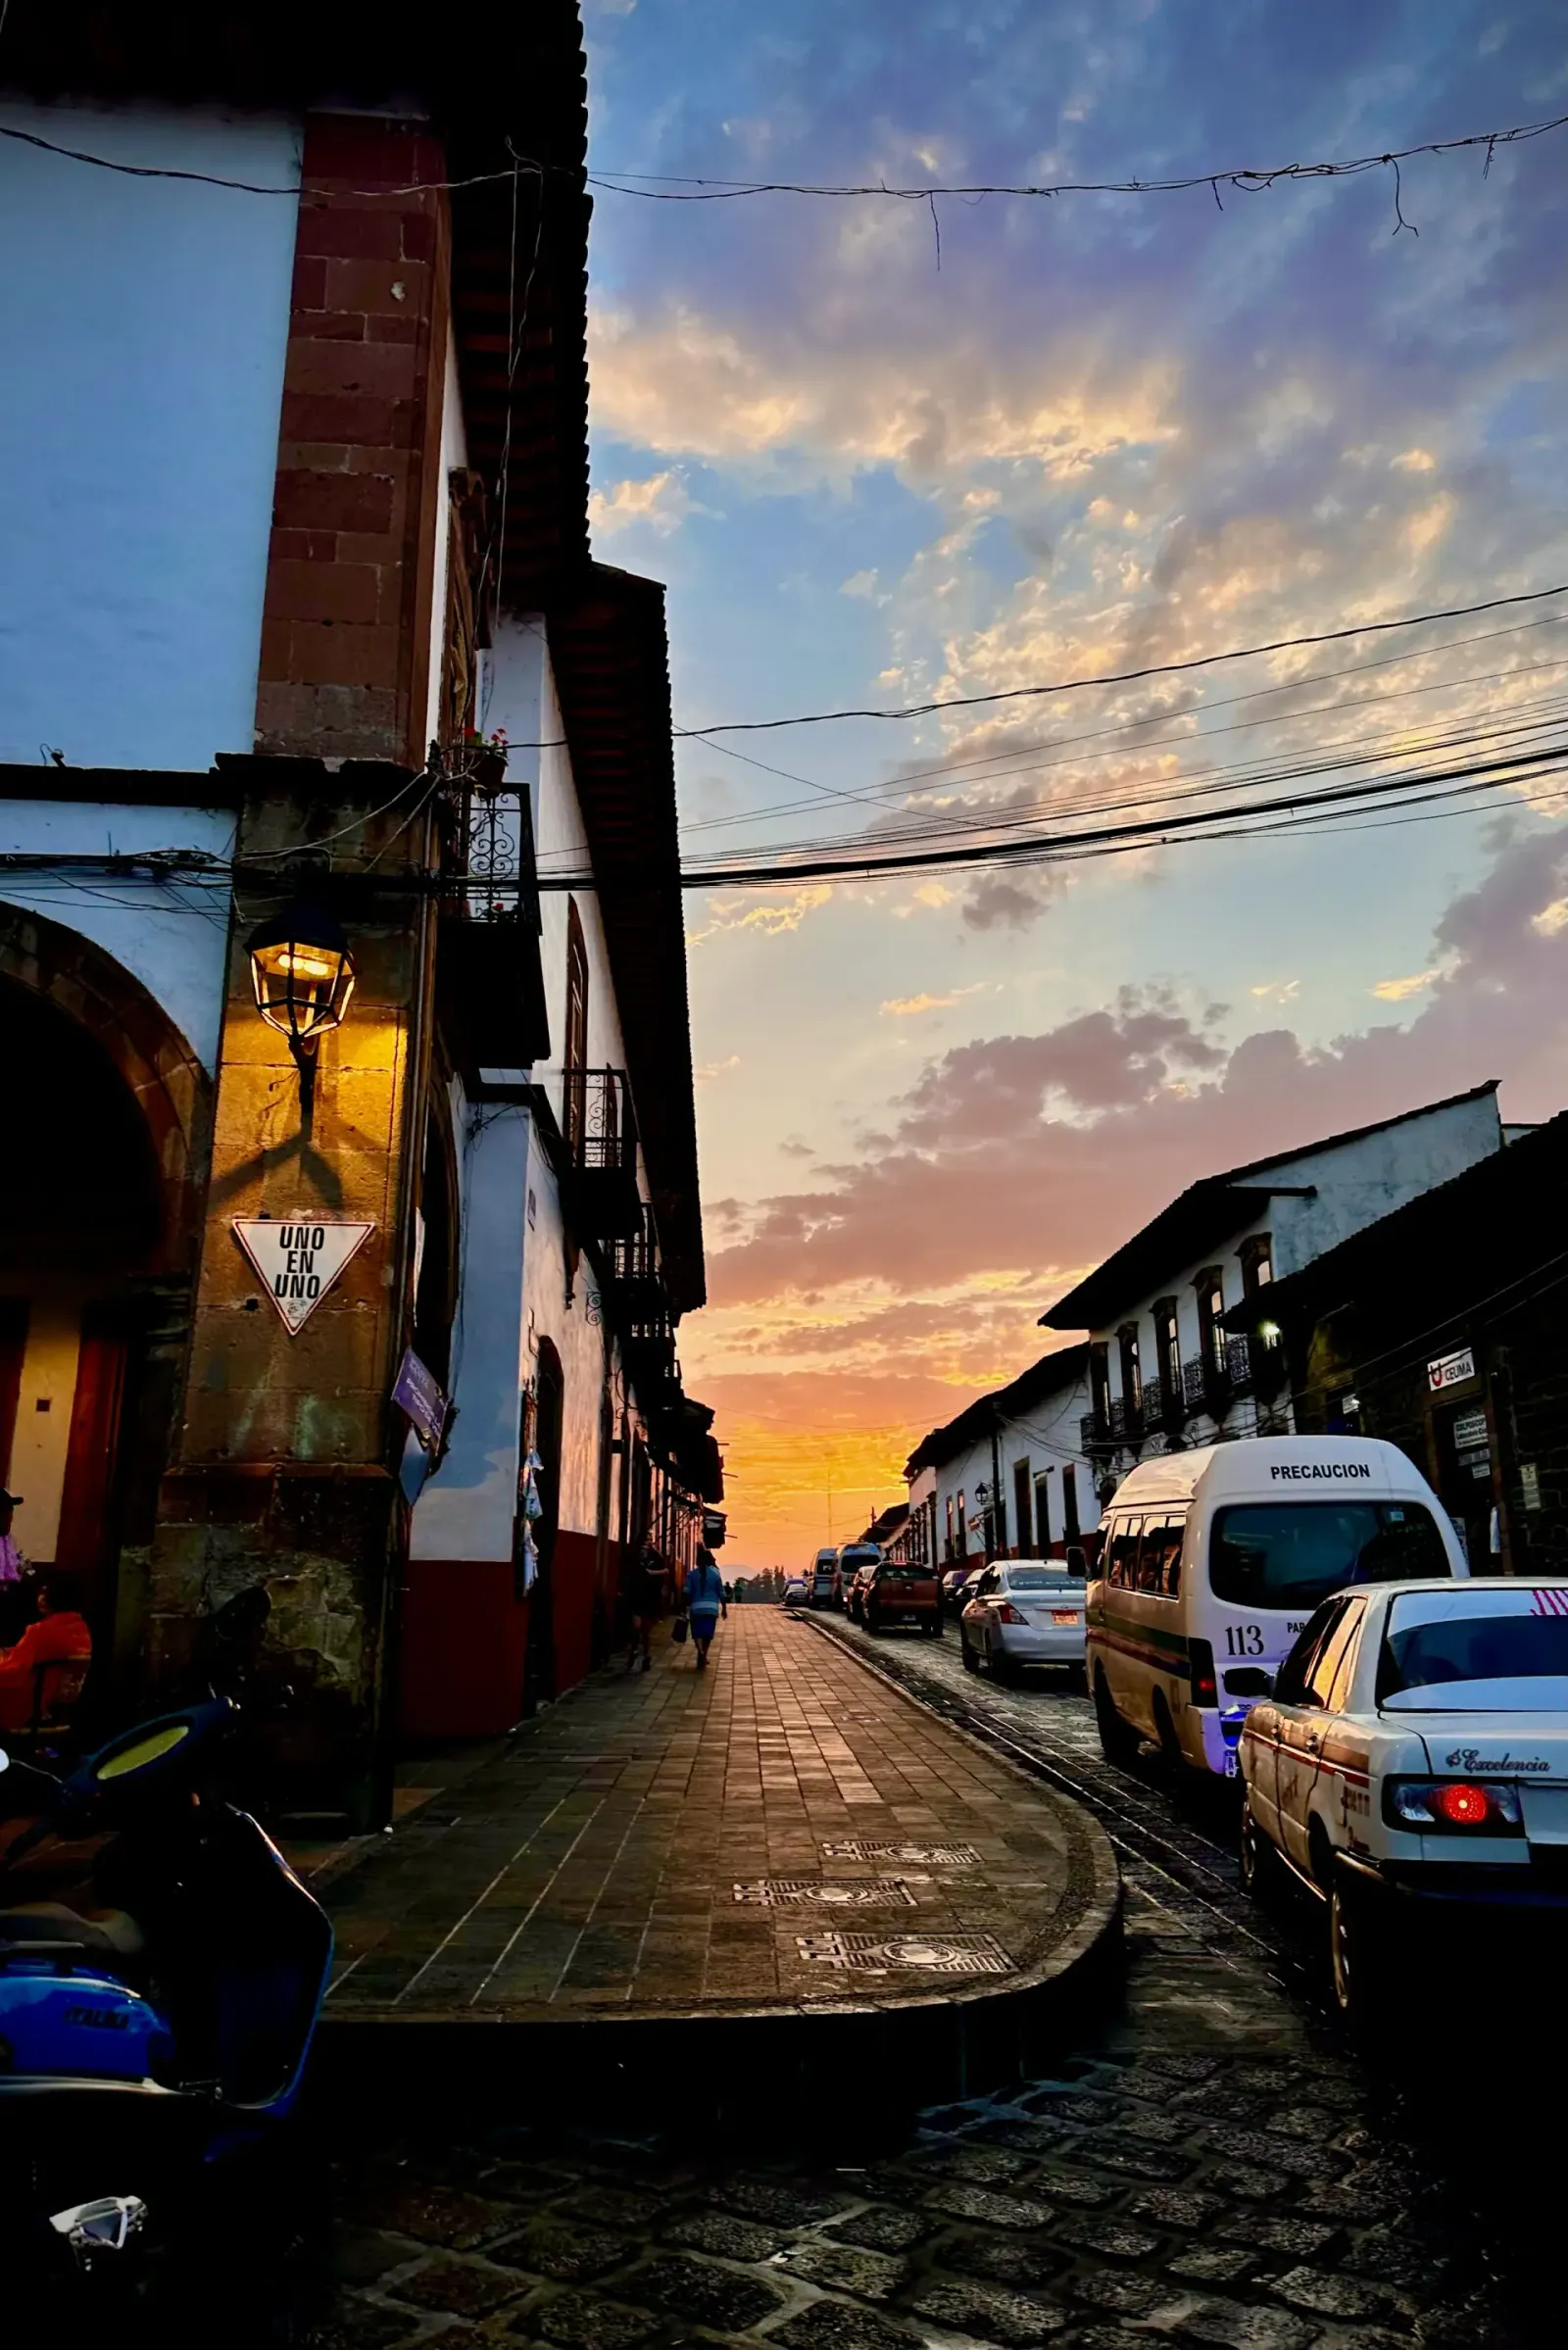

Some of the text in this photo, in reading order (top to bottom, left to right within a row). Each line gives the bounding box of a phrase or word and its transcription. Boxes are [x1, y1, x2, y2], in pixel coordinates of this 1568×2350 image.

[279, 1226, 324, 1250] UNO
[286, 1250, 314, 1274] EN
[274, 1274, 319, 1299] UNO
[1445, 1361, 1473, 1382] CEUMA
[1270, 1464, 1371, 1480] PRECAUCION
[1225, 1625, 1264, 1656] 113
